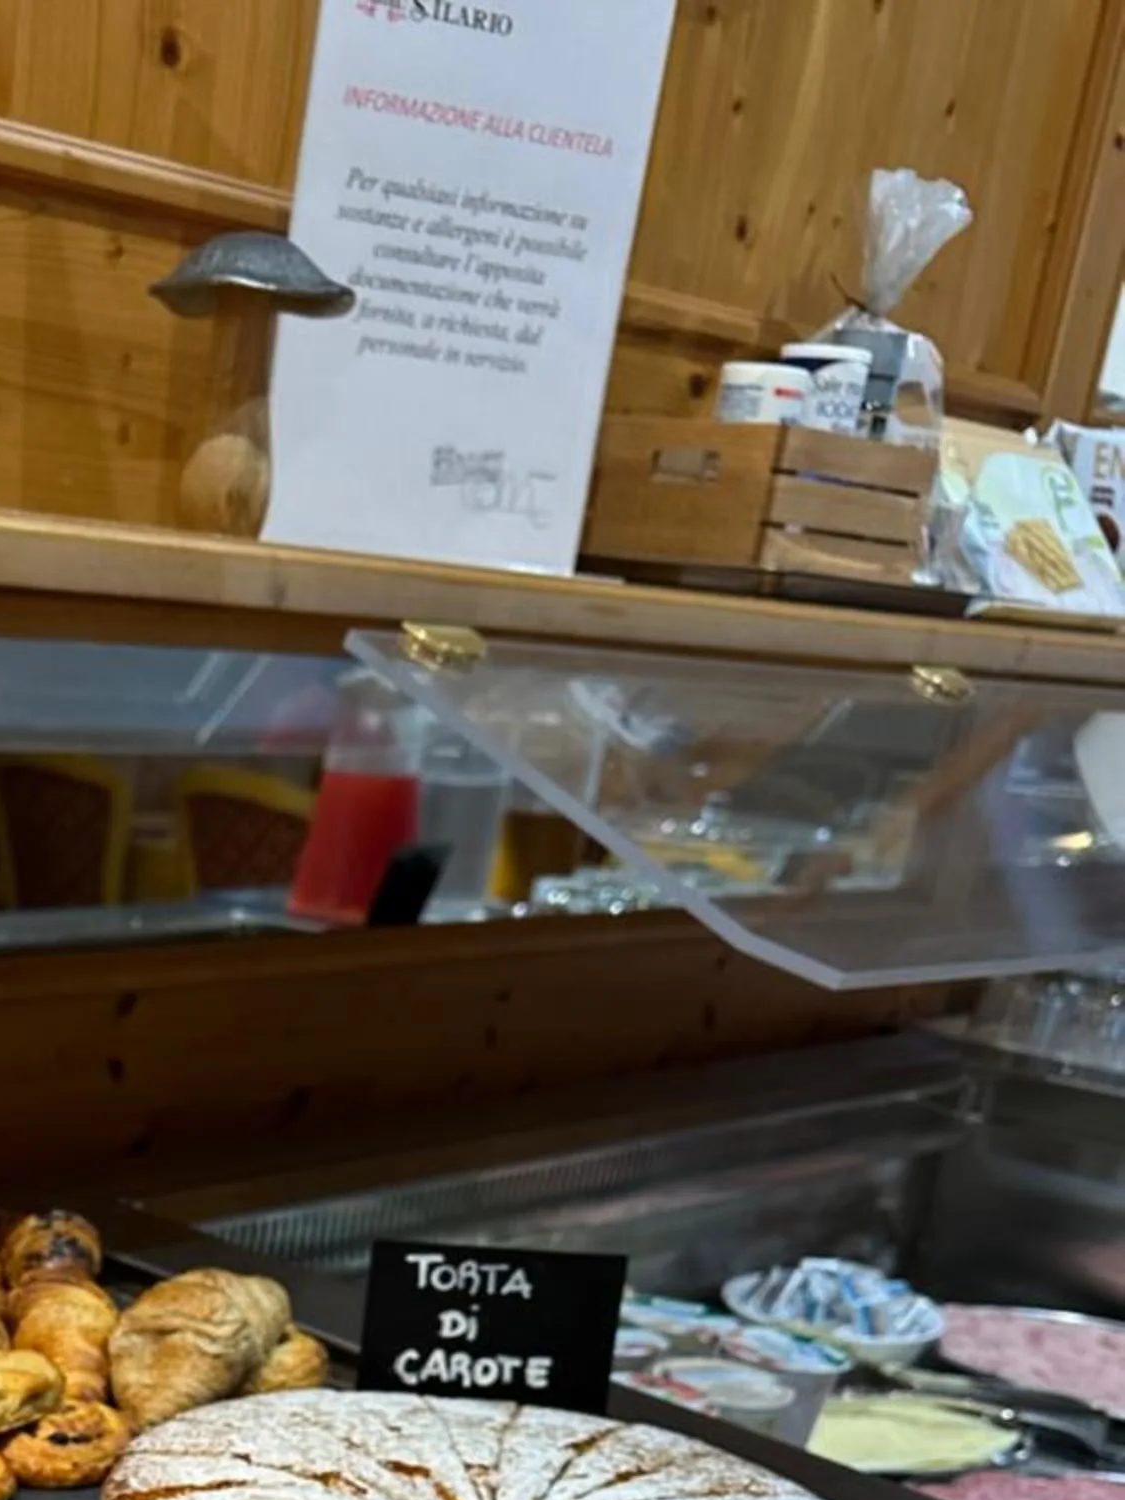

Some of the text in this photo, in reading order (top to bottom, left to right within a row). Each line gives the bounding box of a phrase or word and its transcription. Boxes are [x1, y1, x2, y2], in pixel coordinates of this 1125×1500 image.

[344, 85, 614, 157] INFORMAZIONE ALLA CLIENTELA
[346, 167, 379, 192] Per
[405, 1253, 533, 1300] TORTA
[393, 1348, 553, 1390] CAROTE
